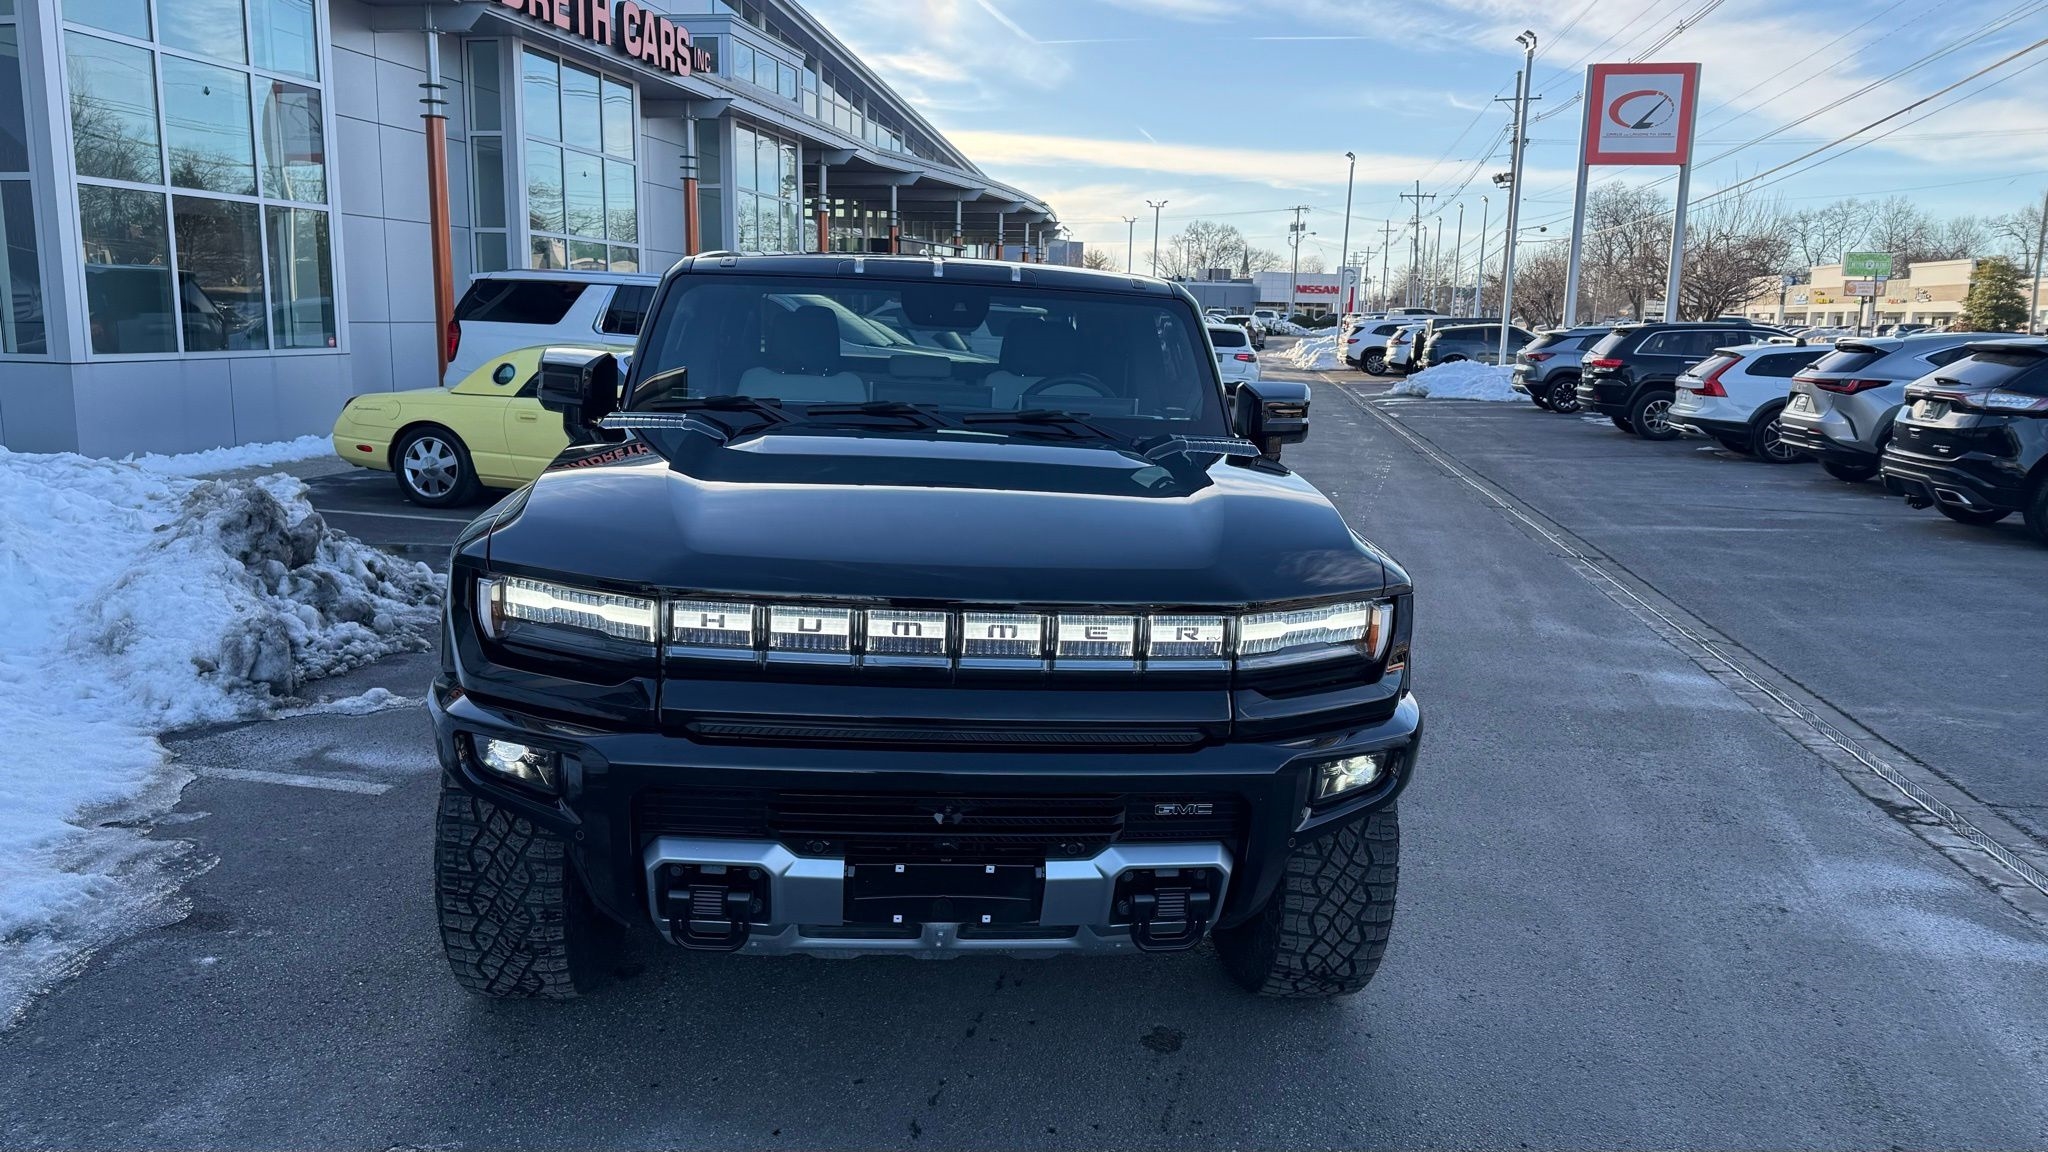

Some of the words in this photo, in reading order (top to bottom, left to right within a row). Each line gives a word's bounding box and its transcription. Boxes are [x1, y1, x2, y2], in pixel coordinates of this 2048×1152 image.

[500, 0, 611, 46] ETH
[623, 0, 691, 77] CARS
[694, 46, 711, 73] INC
[1295, 284, 1340, 295] NISSAN
[700, 613, 1199, 641] HUMMER
[1154, 802, 1214, 816] GMC
